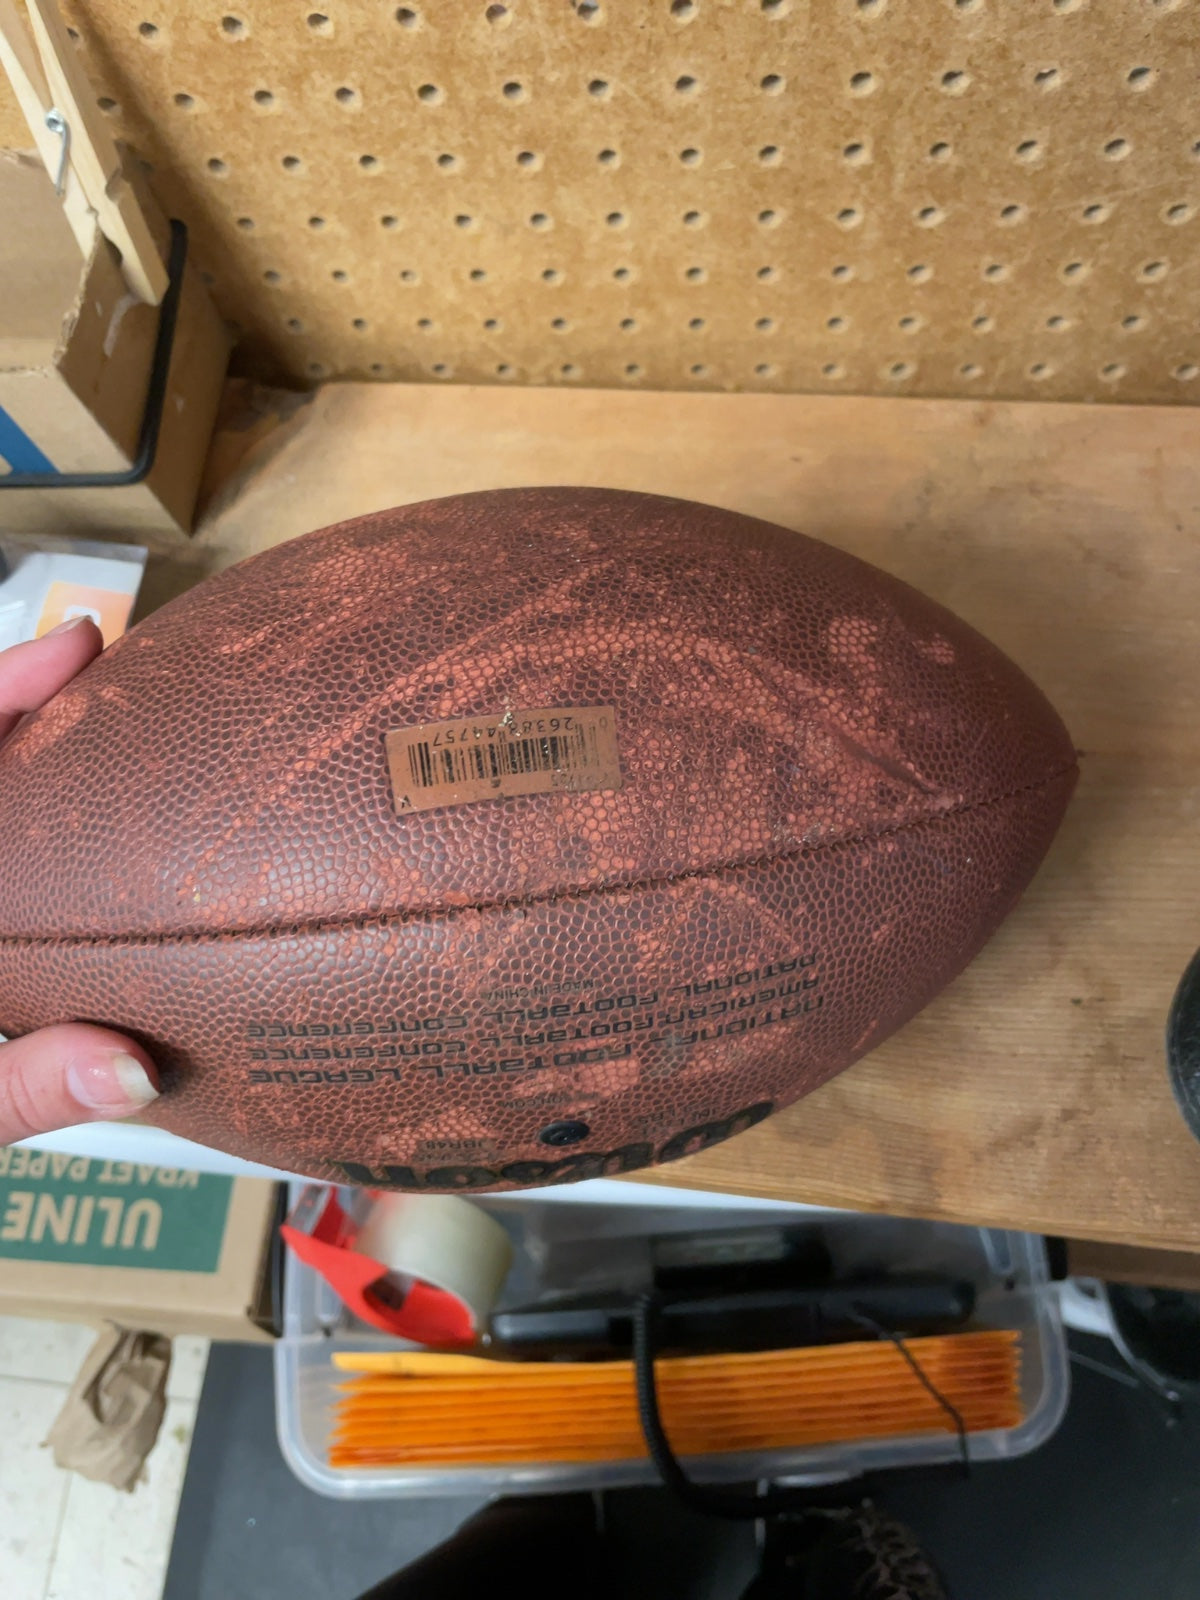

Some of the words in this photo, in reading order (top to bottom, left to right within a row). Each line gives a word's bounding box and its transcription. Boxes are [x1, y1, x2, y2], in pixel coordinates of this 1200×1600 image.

[432, 726, 499, 747] 44757
[672, 953, 816, 996] NATIONAL
[482, 992, 659, 1024] FOOTBALL
[666, 976, 820, 1024] AMERICAN
[248, 1016, 468, 1038] CONFERENCE
[479, 1017, 654, 1046] FOOTBALL
[650, 996, 825, 1045] NATIONAL
[251, 1040, 467, 1061] CONFERENCE
[418, 1044, 632, 1078] FOOTBALL
[250, 1069, 401, 1083] LEAGUE
[1, 1191, 162, 1251] ULINE
